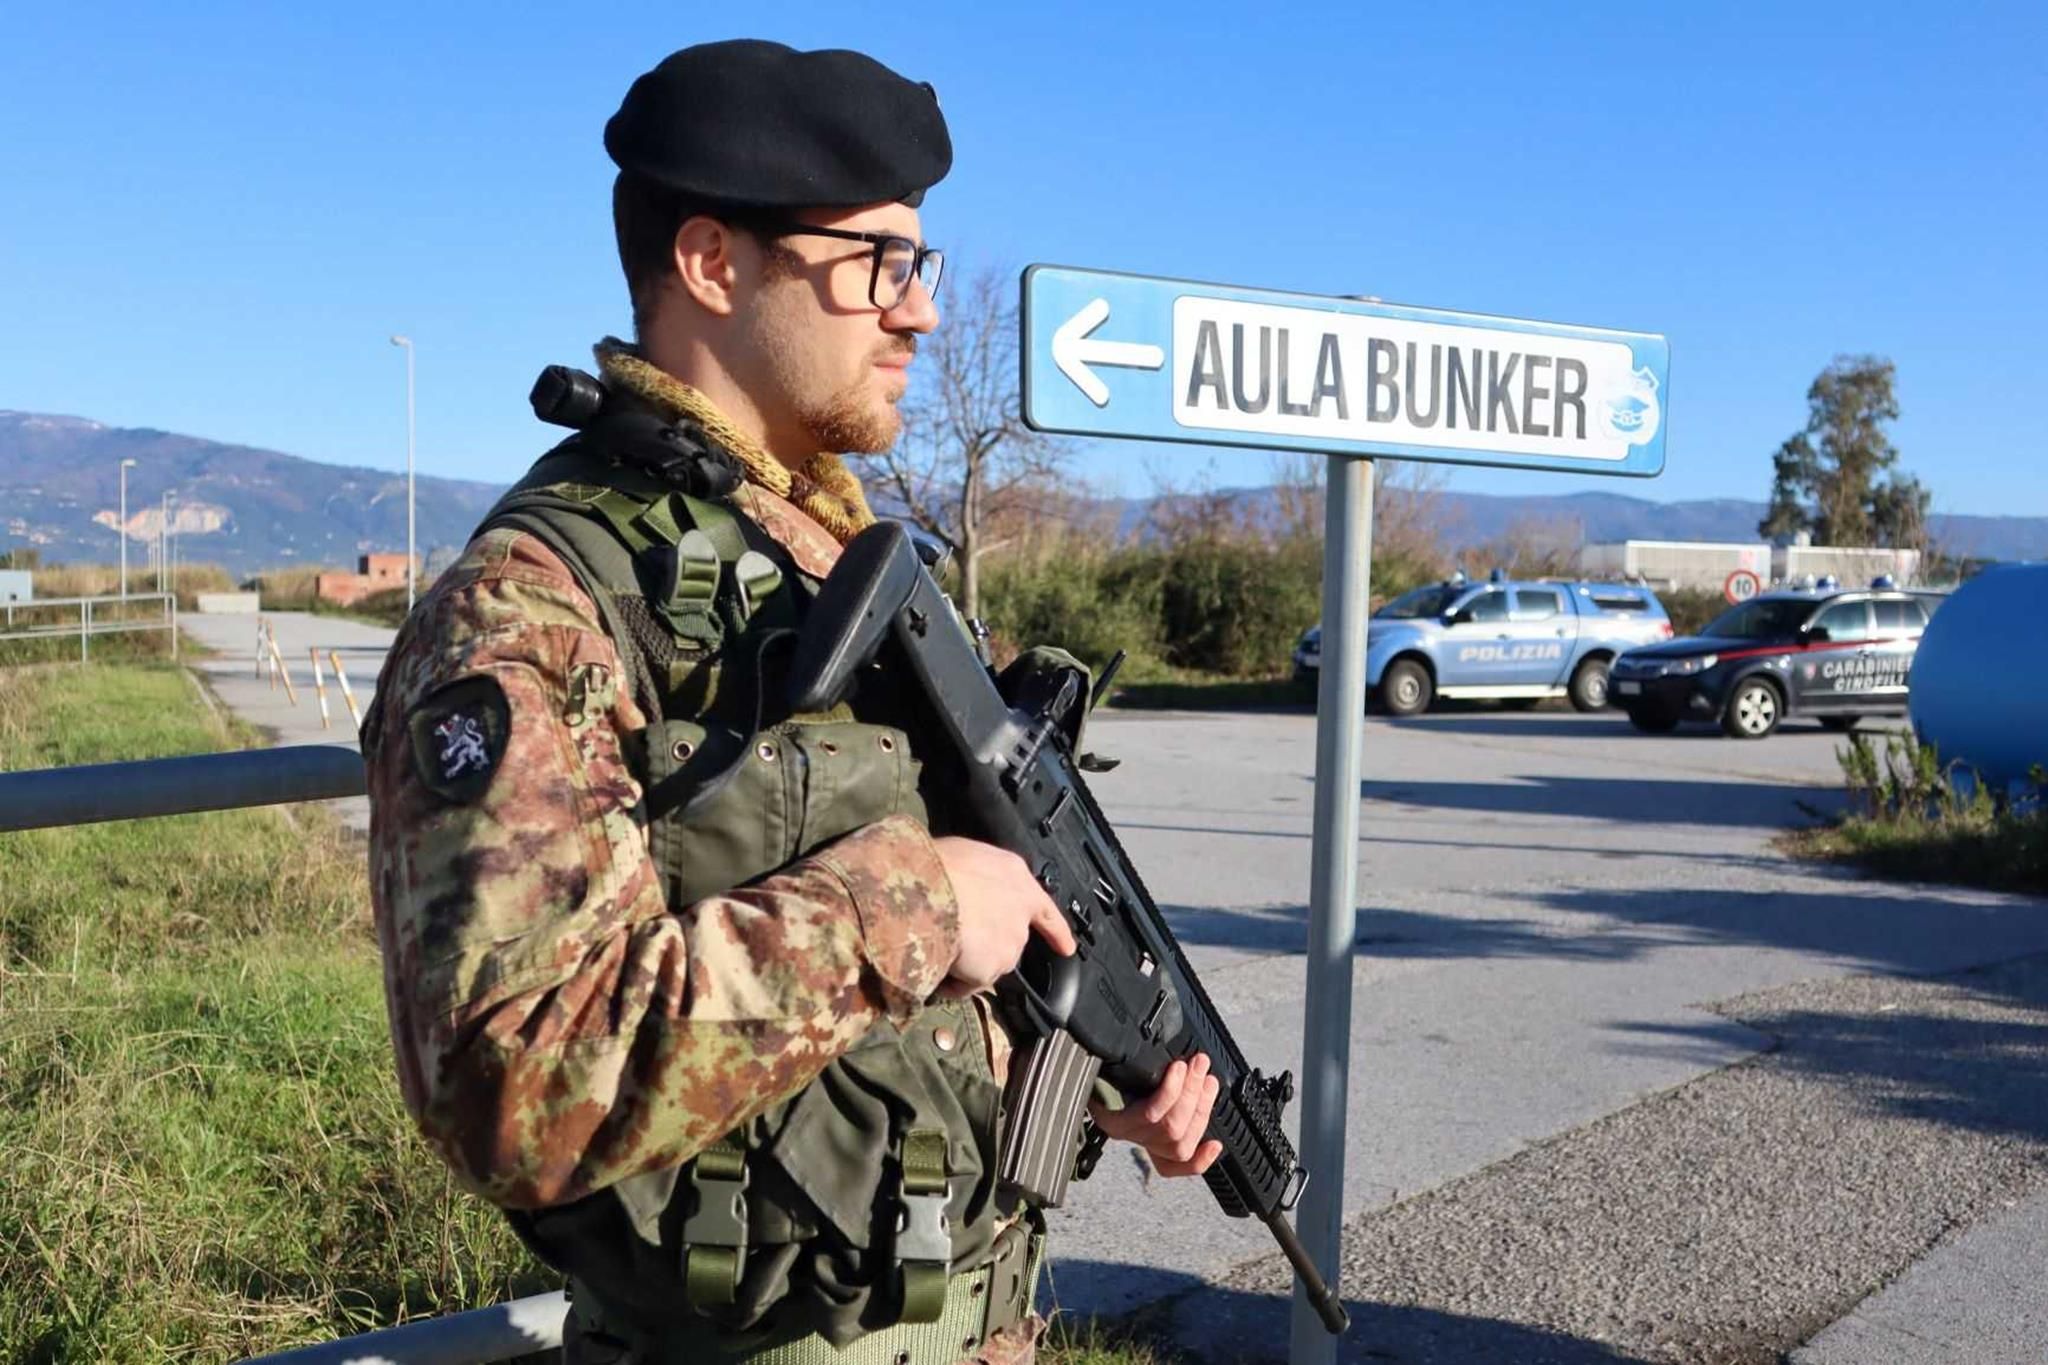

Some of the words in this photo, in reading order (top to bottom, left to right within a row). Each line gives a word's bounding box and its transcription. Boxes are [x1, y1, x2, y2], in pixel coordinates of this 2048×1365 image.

[1186, 319, 1349, 420] AULA
[1366, 337, 1589, 439] BUNKER
[1735, 579, 1752, 596] 10
[1459, 643, 1562, 662] POLIZIA
